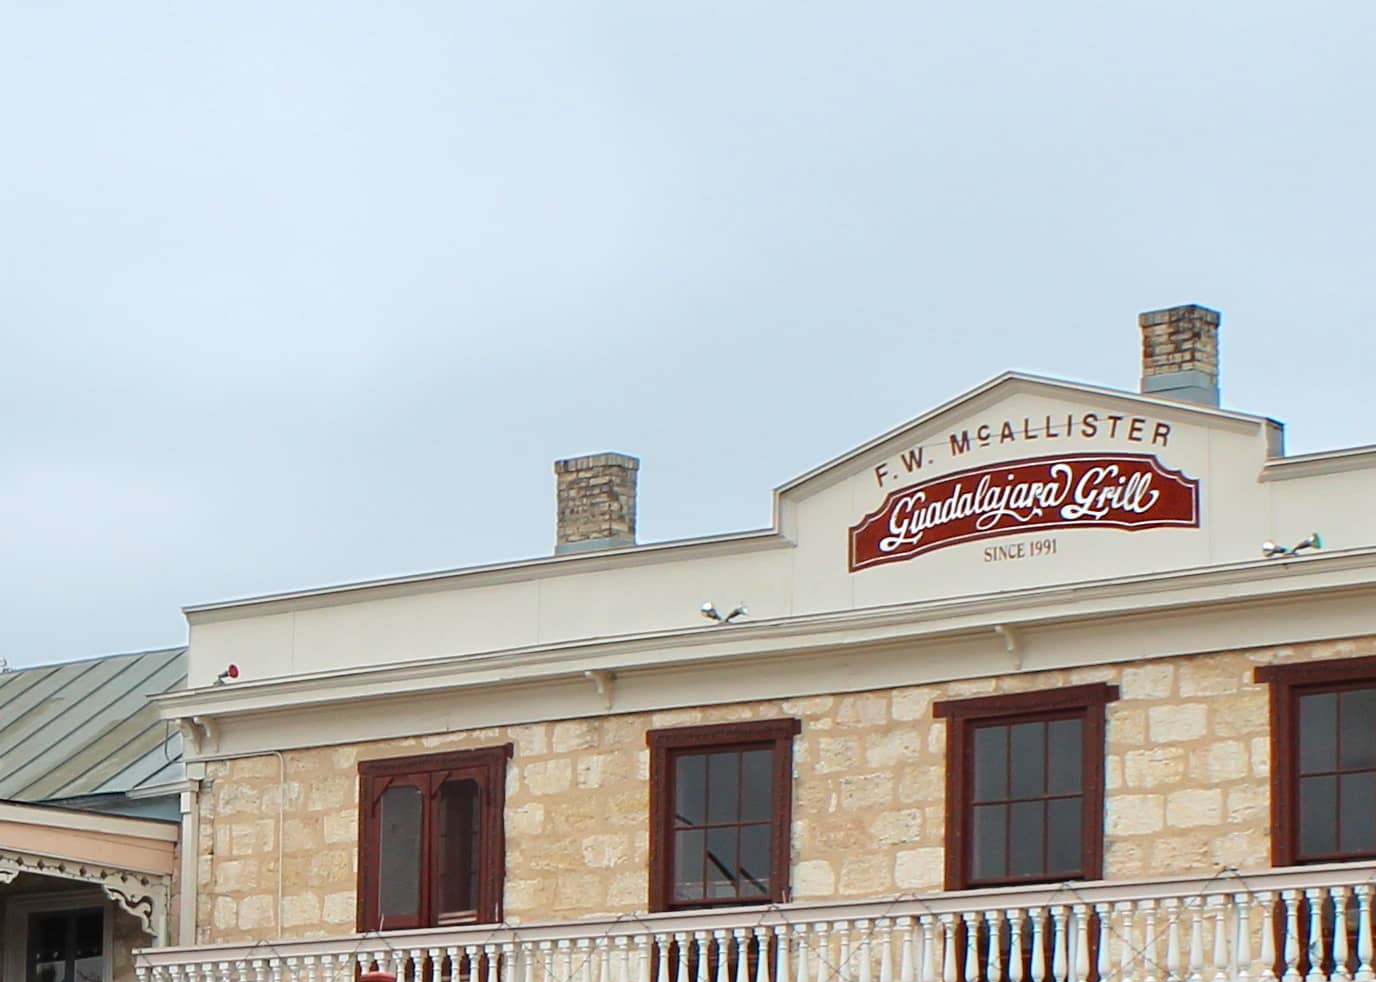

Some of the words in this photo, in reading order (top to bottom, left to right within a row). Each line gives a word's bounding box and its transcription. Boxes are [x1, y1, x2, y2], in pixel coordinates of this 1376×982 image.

[878, 463, 1071, 553] Guadalajara
[1060, 465, 1159, 520] Grill
[984, 542, 1026, 562] SINCE
[1030, 538, 1057, 557] 1991
